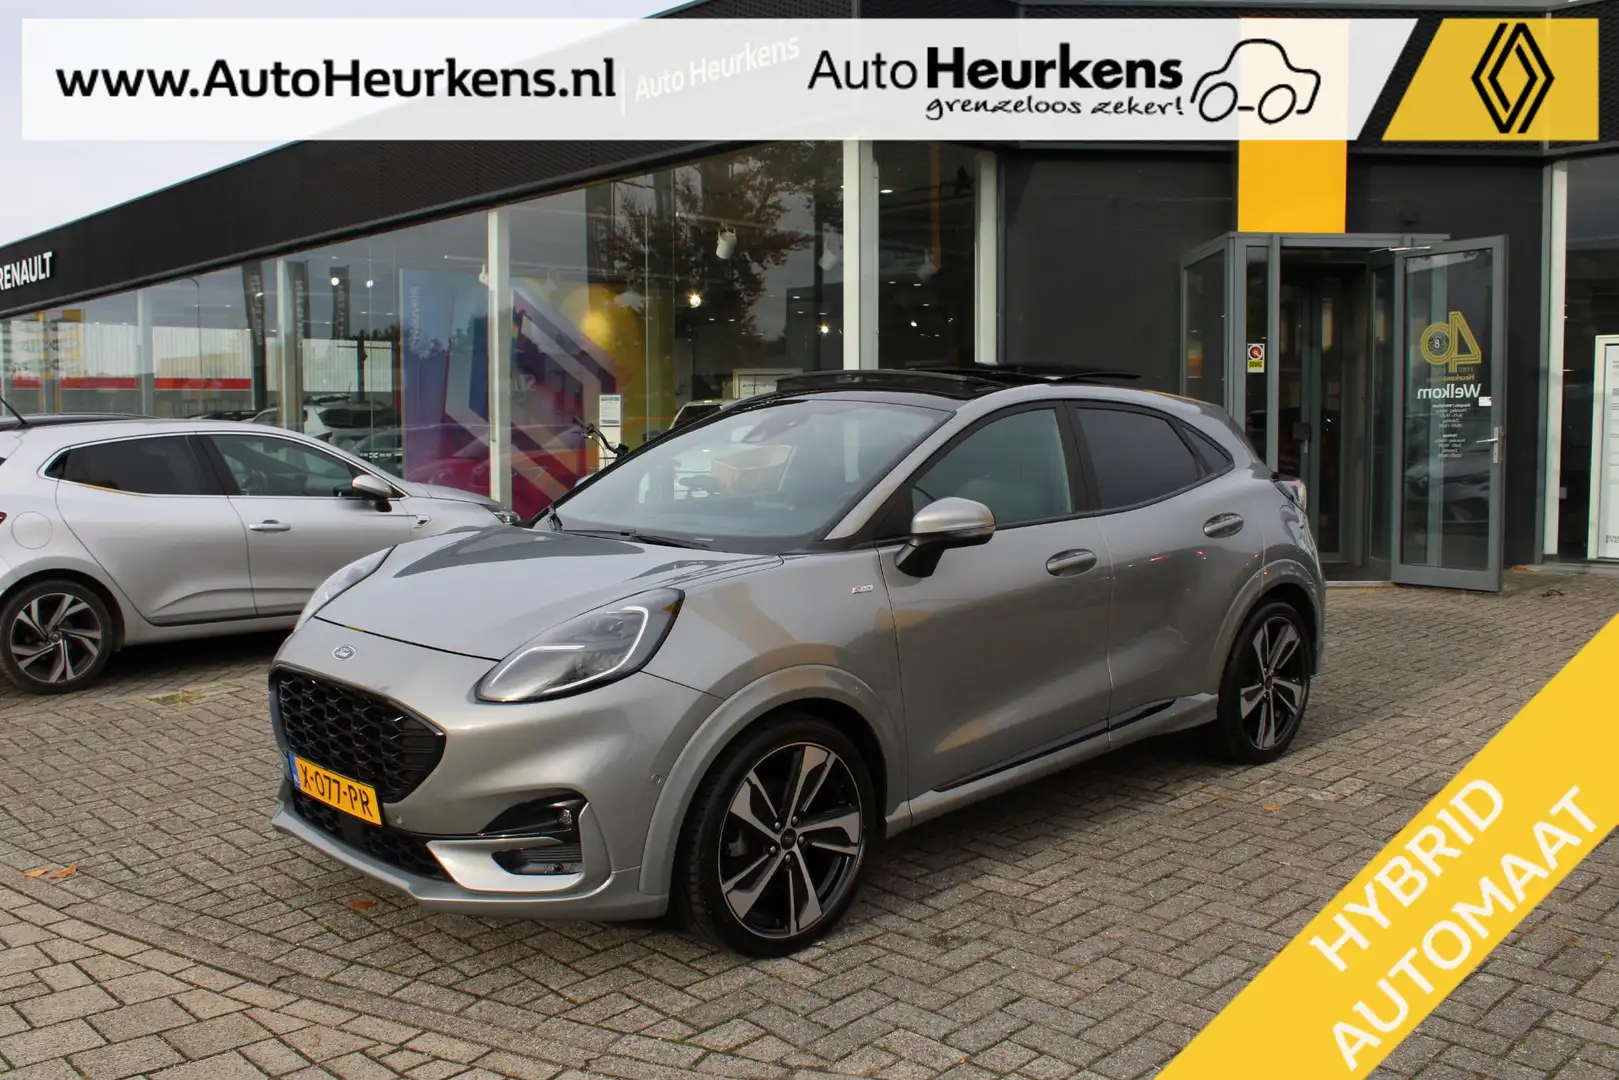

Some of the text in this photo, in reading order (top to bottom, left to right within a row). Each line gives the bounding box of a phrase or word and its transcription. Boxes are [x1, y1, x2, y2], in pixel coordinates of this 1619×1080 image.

[635, 36, 800, 103] Auto Heurkens
[0, 251, 53, 290] RENAULT
[299, 763, 373, 818] X-077-PR
